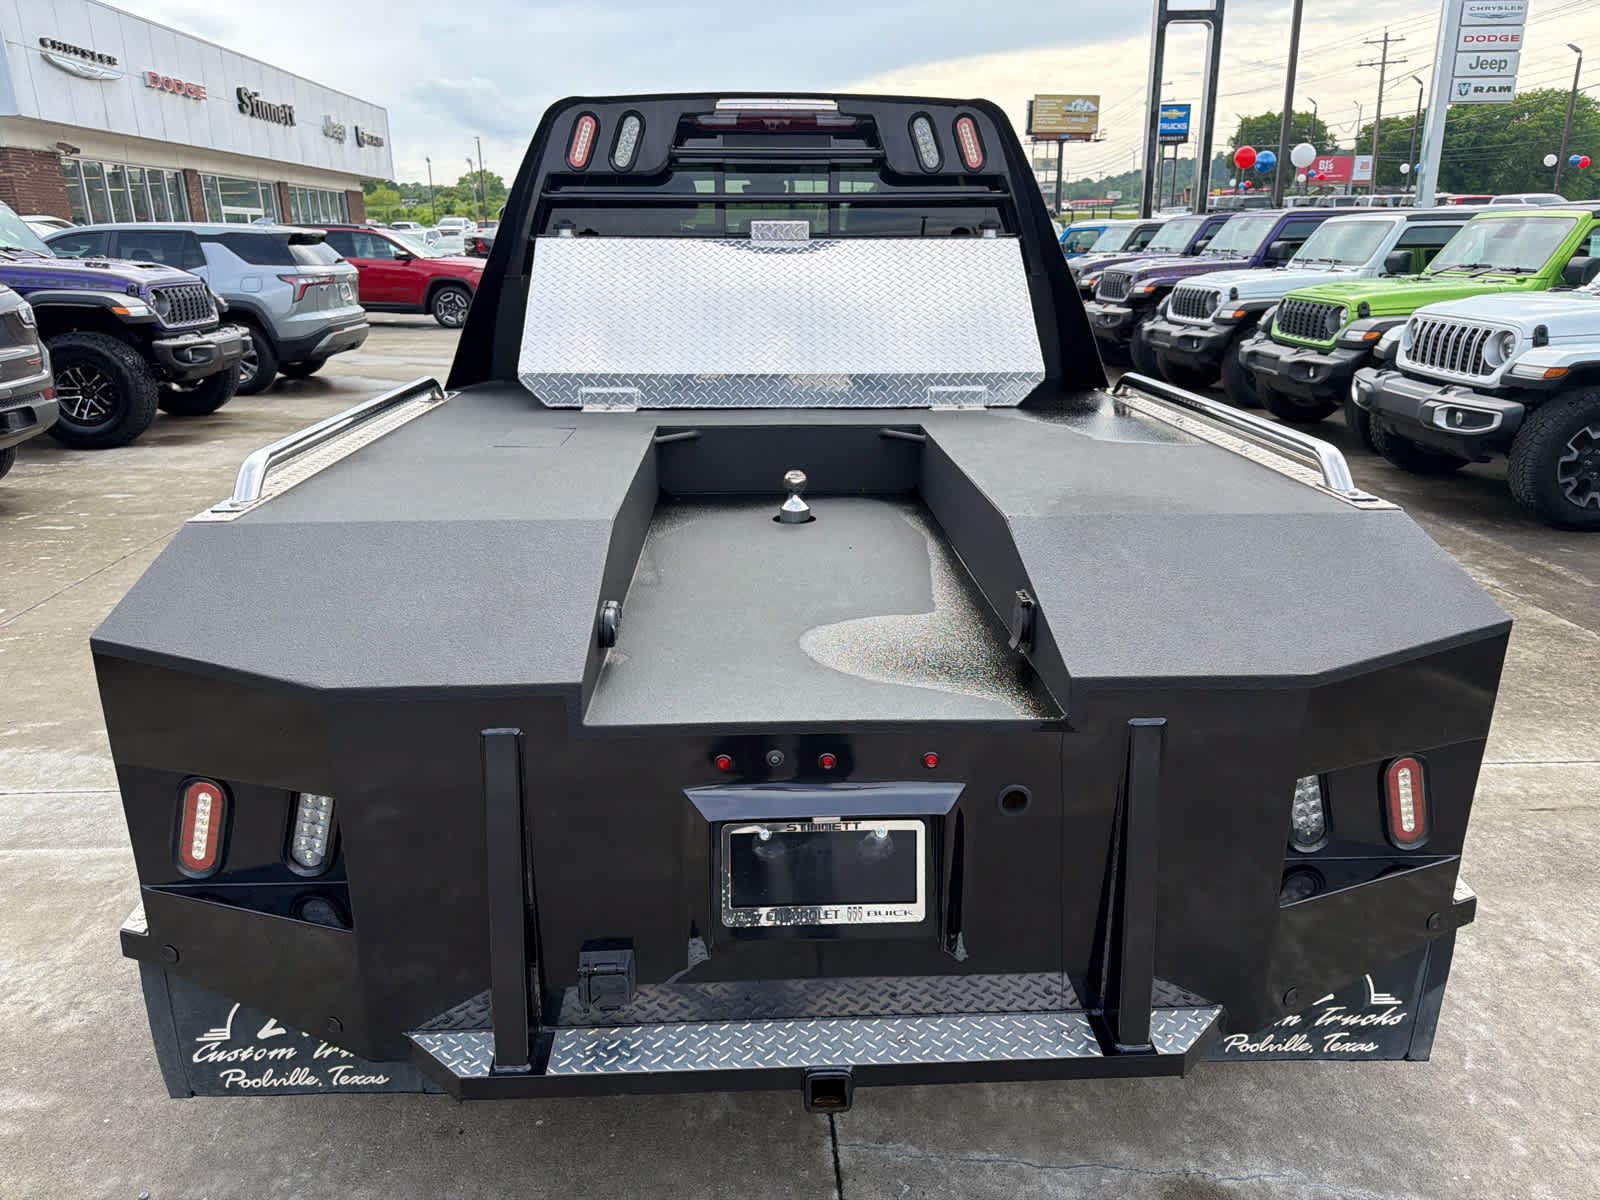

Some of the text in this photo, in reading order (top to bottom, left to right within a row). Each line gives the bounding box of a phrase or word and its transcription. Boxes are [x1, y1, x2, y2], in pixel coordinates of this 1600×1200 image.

[39, 37, 118, 65] CHRYSLER
[1469, 56, 1508, 72] Jeep
[145, 71, 207, 100] DODGE
[236, 87, 296, 127] Stinnett
[1314, 1006, 1407, 1026] Trucks
[192, 1041, 297, 1063] Custom
[1224, 1032, 1379, 1053] Poolville, Texas
[220, 1065, 390, 1088] Poolville, Texas
